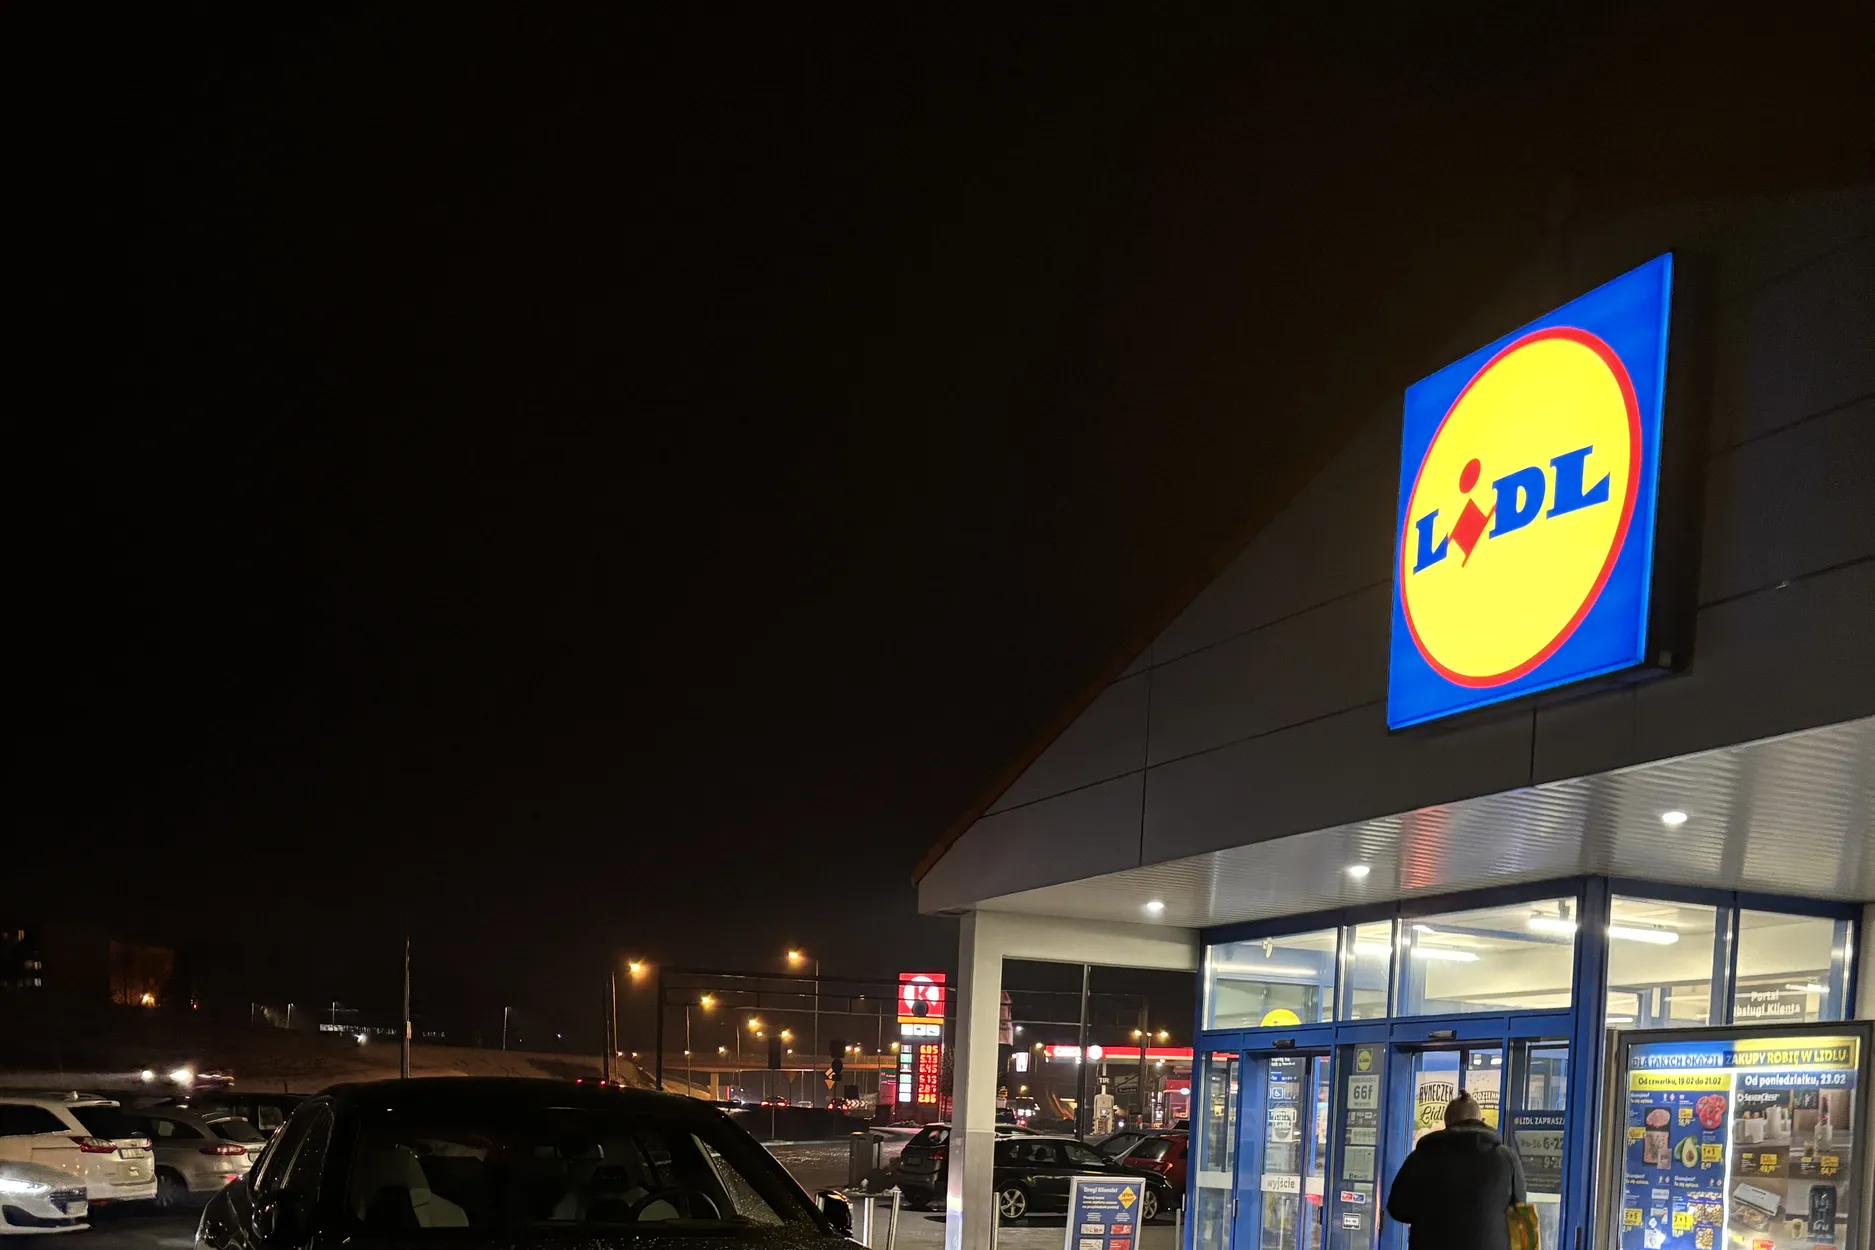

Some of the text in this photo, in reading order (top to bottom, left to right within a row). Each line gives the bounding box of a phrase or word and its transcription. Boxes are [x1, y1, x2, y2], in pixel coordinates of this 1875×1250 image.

[1726, 1051, 1766, 1065] ZAKUPY
[1767, 1050, 1799, 1066] ROBIĘ
[1801, 1049, 1814, 1063] W
[1814, 1048, 1848, 1063] LIDLU
[1638, 1077, 1648, 1085] Od
[1695, 1077, 1704, 1085] do
[1744, 1075, 1758, 1086] Od
[1820, 1073, 1847, 1085] 23.02
[1419, 1082, 1454, 1104] RYNECZEK
[1520, 1116, 1533, 1125] LIDL
[1267, 1178, 1295, 1190] wyjście
